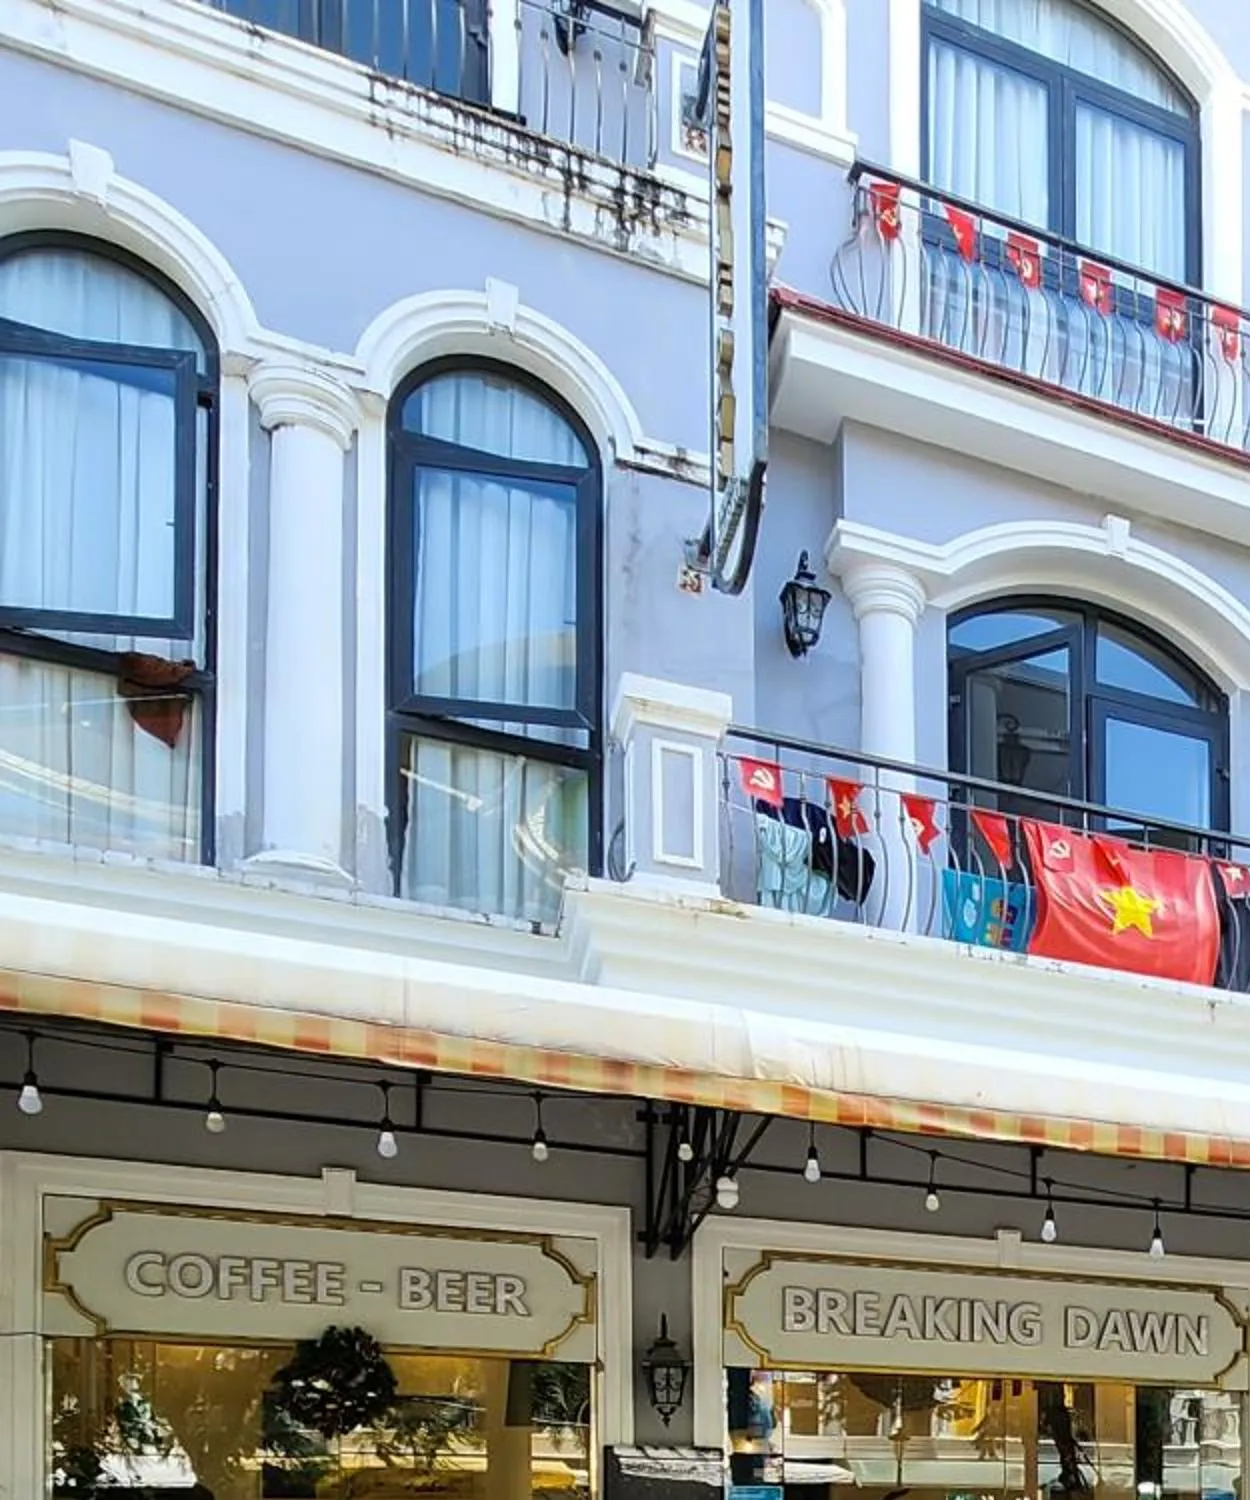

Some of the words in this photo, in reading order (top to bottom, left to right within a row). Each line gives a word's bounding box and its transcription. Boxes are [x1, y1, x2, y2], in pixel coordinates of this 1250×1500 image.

[124, 1250, 346, 1306] COFFEE
[398, 1267, 531, 1317] BEER
[781, 1285, 1043, 1346] BREAKING
[1063, 1306, 1209, 1356] DAWN
